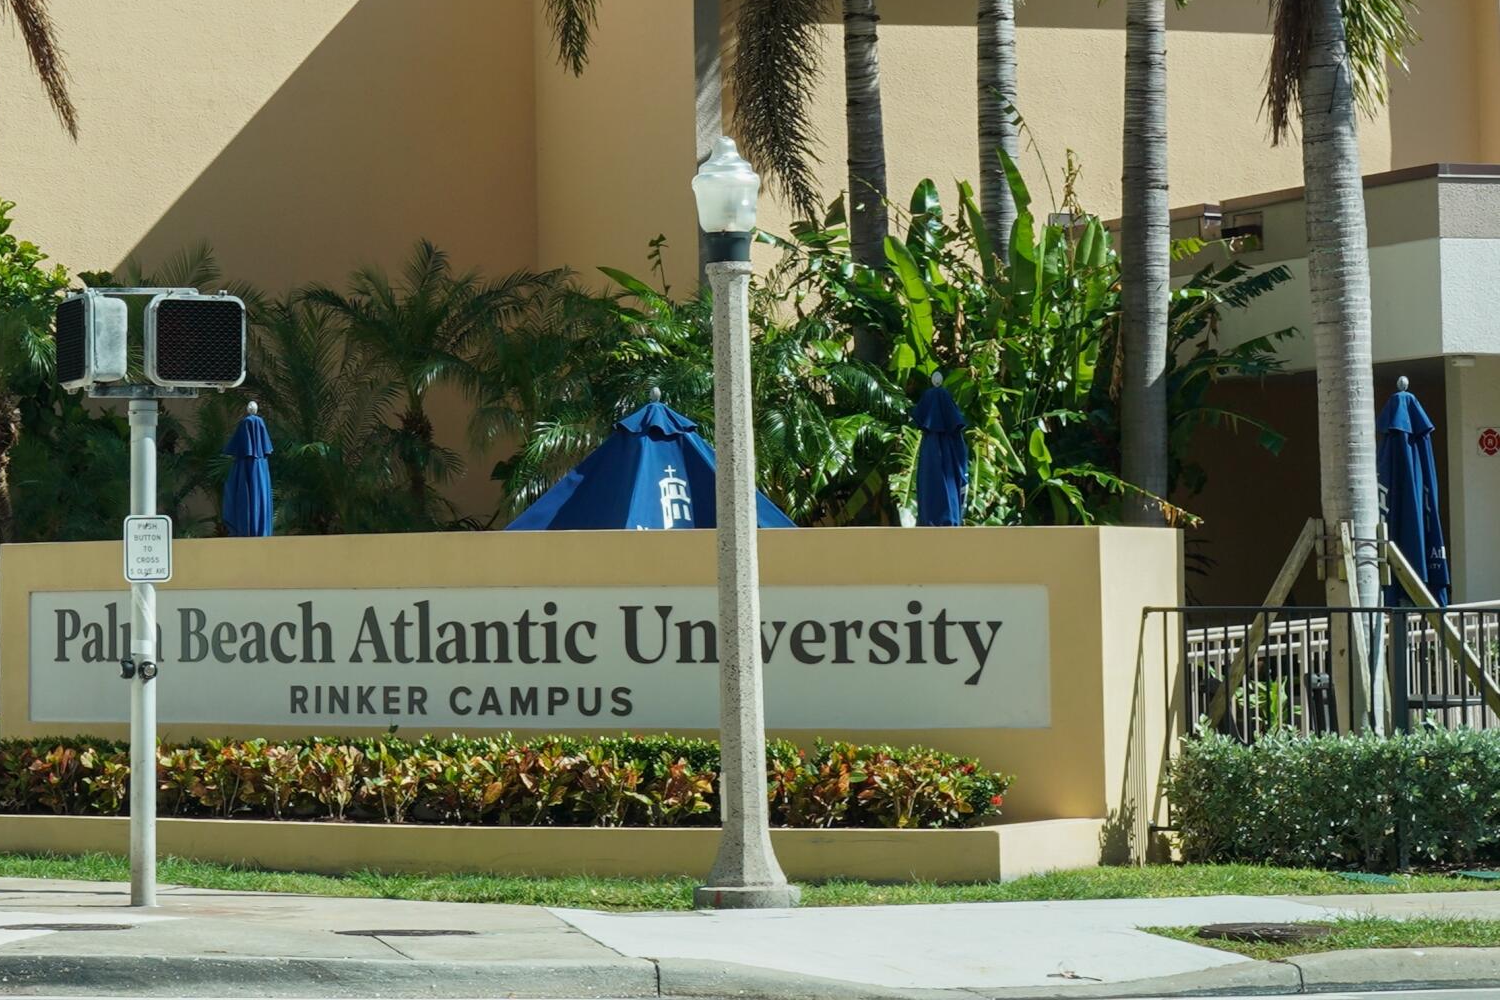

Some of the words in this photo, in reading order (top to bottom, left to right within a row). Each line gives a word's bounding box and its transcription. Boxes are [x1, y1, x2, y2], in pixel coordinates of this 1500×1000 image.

[143, 545, 153, 553] TO
[136, 556, 160, 564] CROSS
[177, 600, 333, 664] Beach
[348, 600, 598, 665] Atlantic
[619, 600, 1003, 686] Unversity
[290, 685, 429, 715] RINKER
[449, 685, 634, 716] CAMPUS
